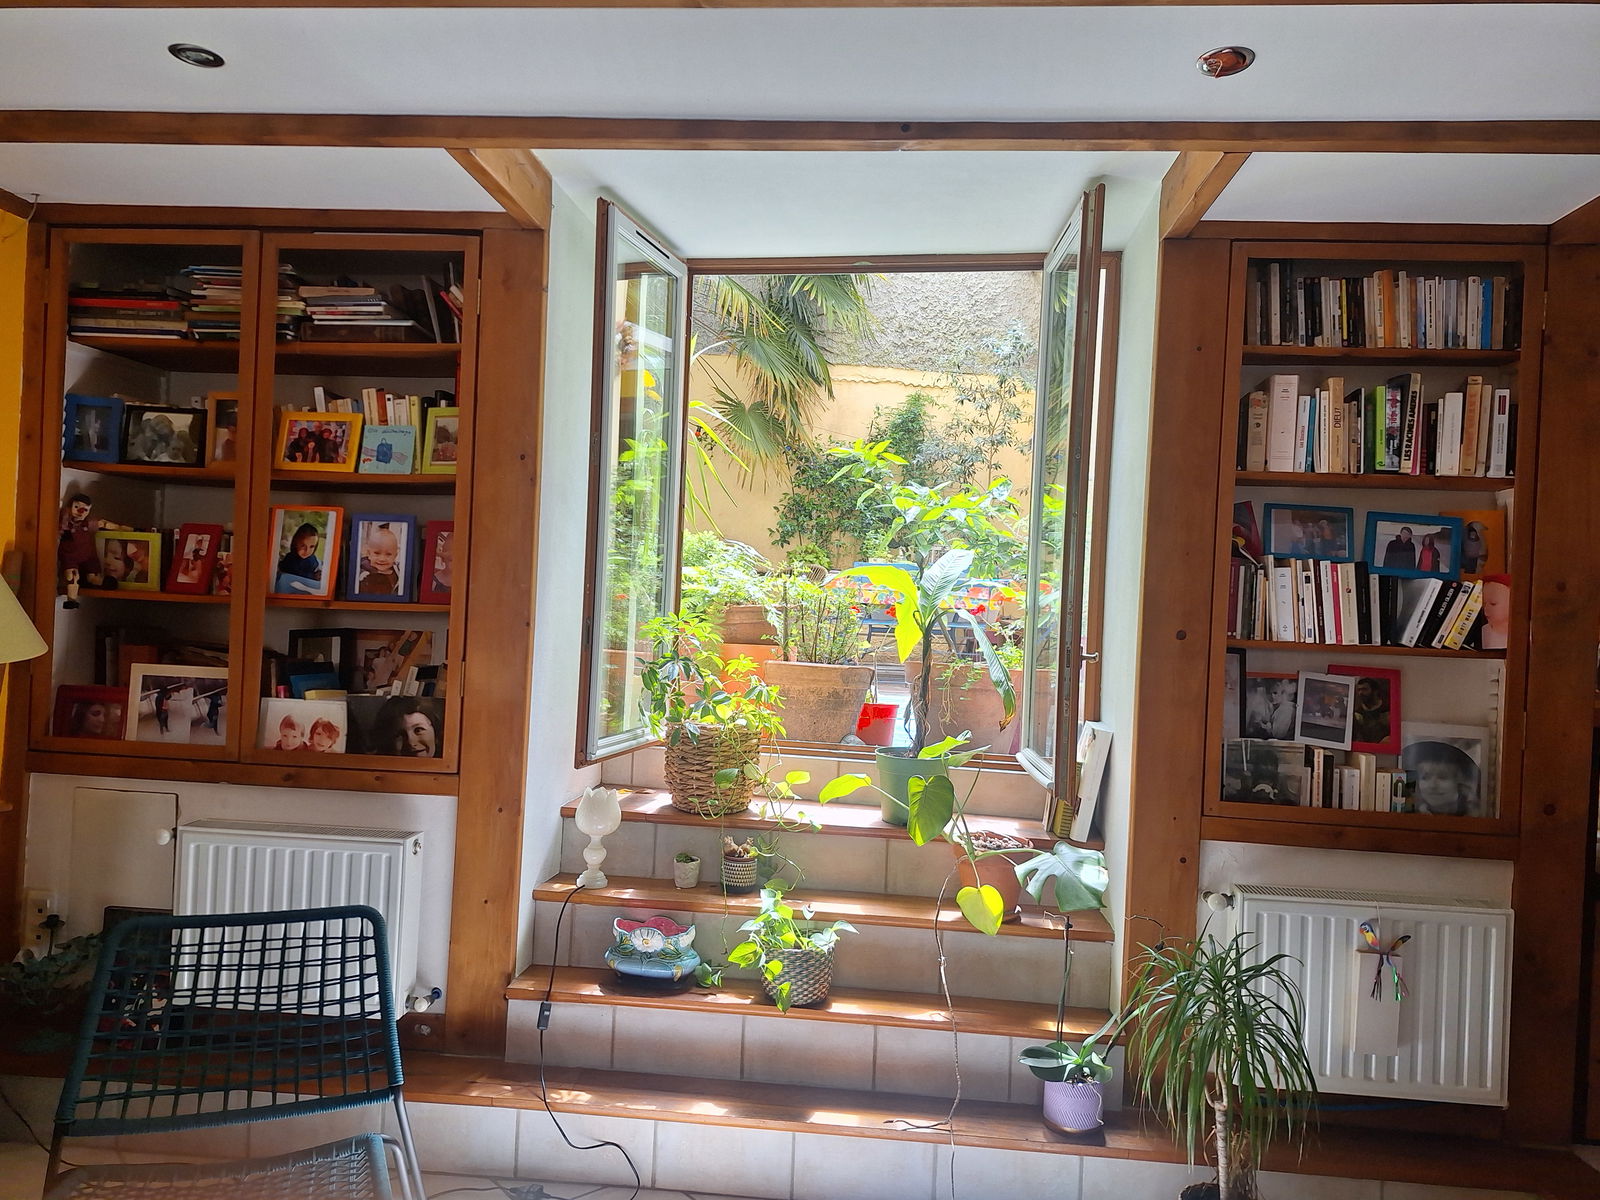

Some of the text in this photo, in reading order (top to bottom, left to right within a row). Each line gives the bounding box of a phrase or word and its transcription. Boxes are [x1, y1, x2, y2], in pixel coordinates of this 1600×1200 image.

[1334, 407, 1342, 429] DIEU?
[1405, 419, 1415, 449] RACINES
[1403, 450, 1412, 461] LES
